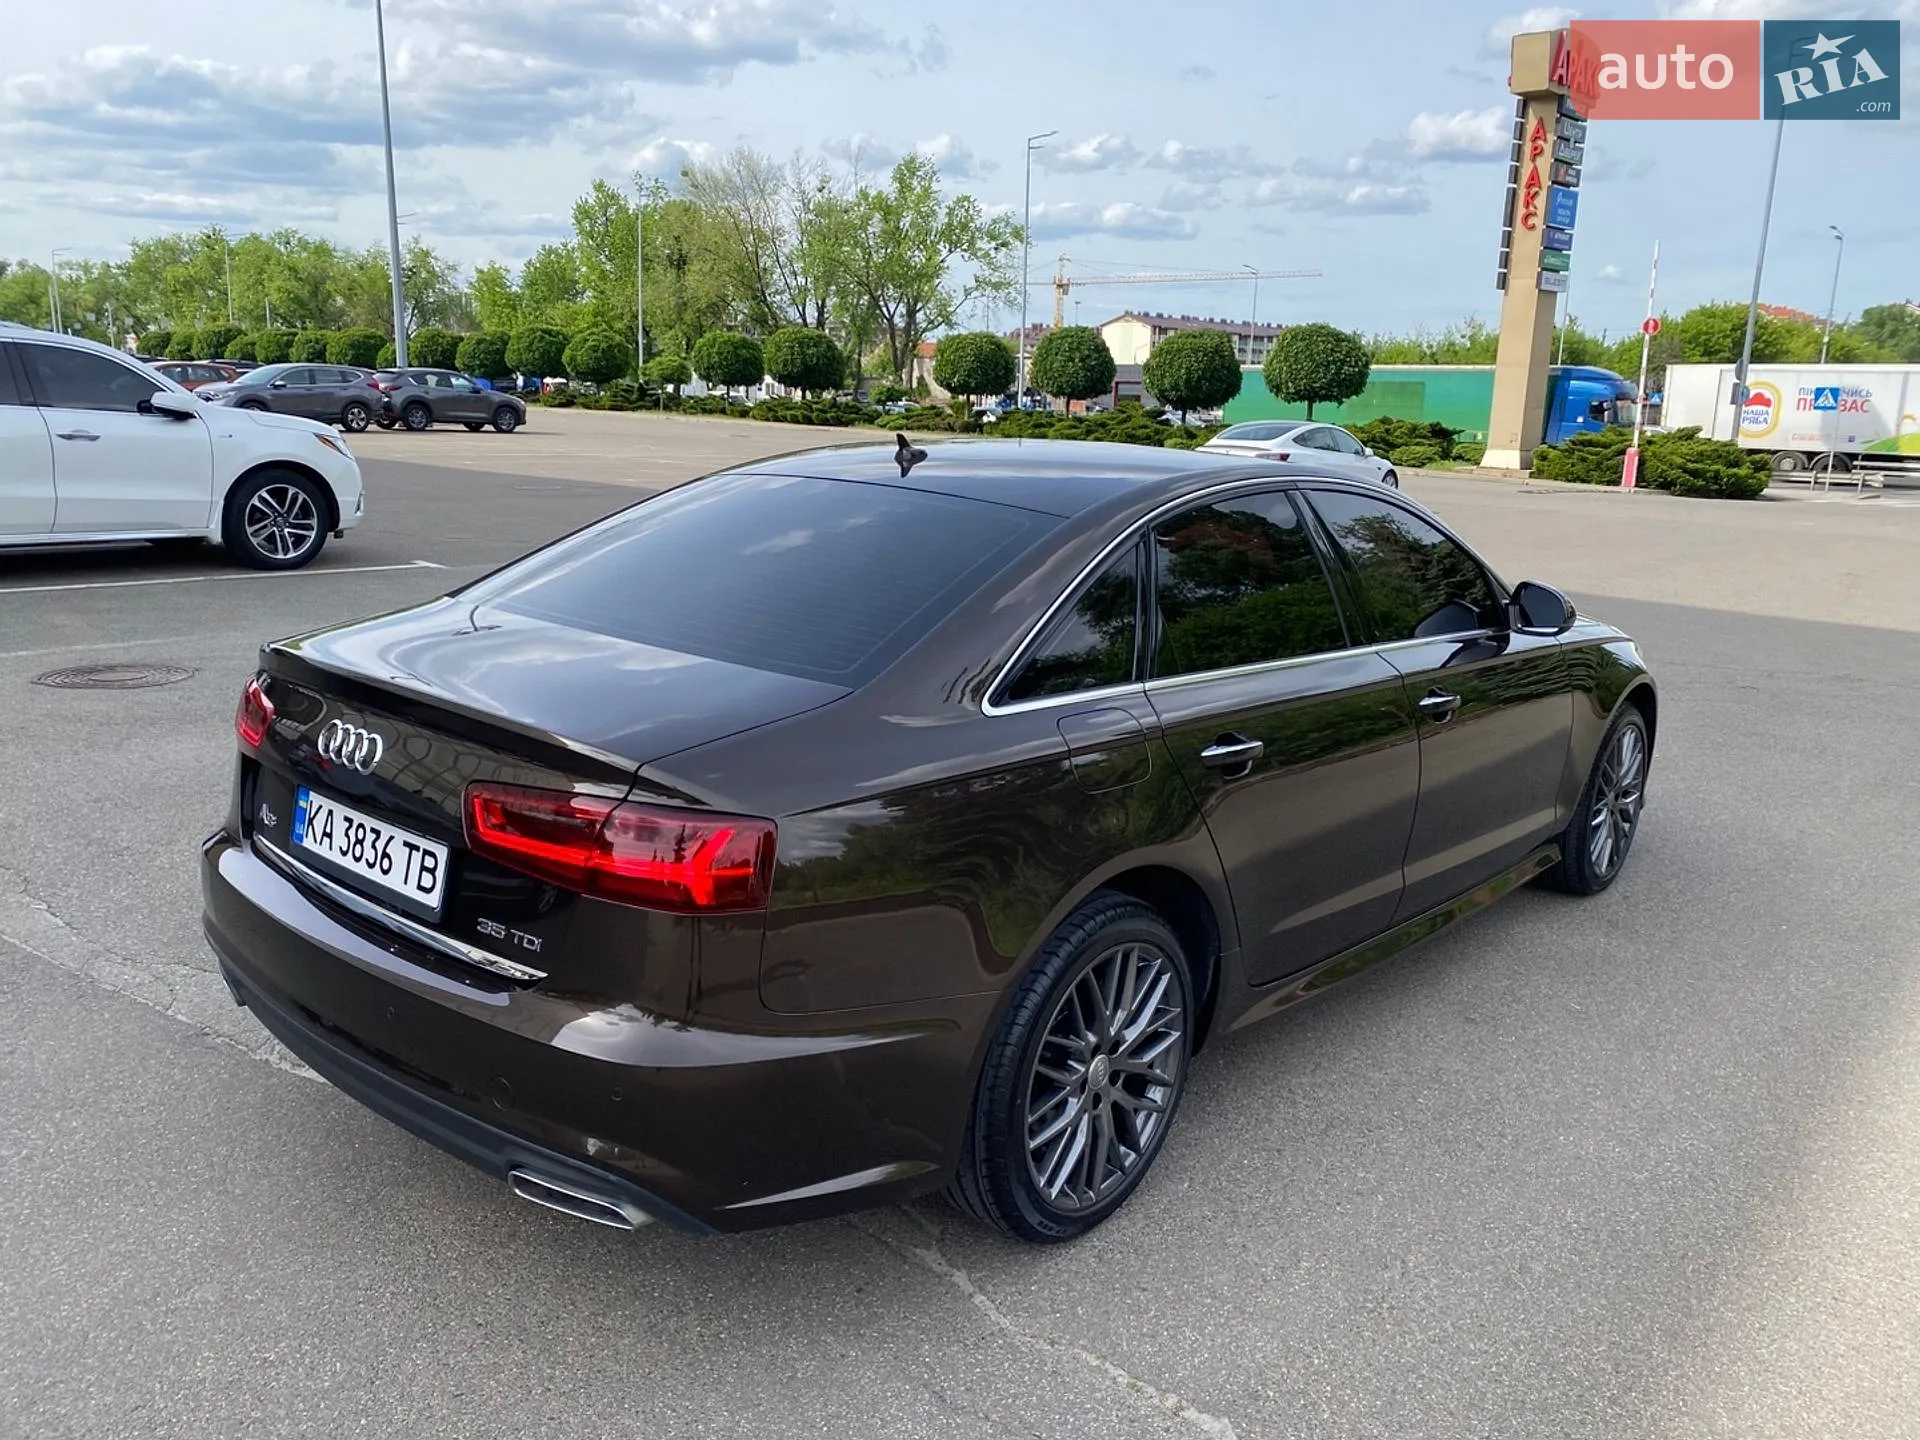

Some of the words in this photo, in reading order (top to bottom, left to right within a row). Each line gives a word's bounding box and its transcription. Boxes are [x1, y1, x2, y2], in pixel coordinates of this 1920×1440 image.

[1520, 116, 1547, 231] АРАКС
[305, 799, 334, 852] KA
[339, 817, 396, 876] 3836
[403, 840, 439, 895] TB
[476, 917, 507, 939] 35
